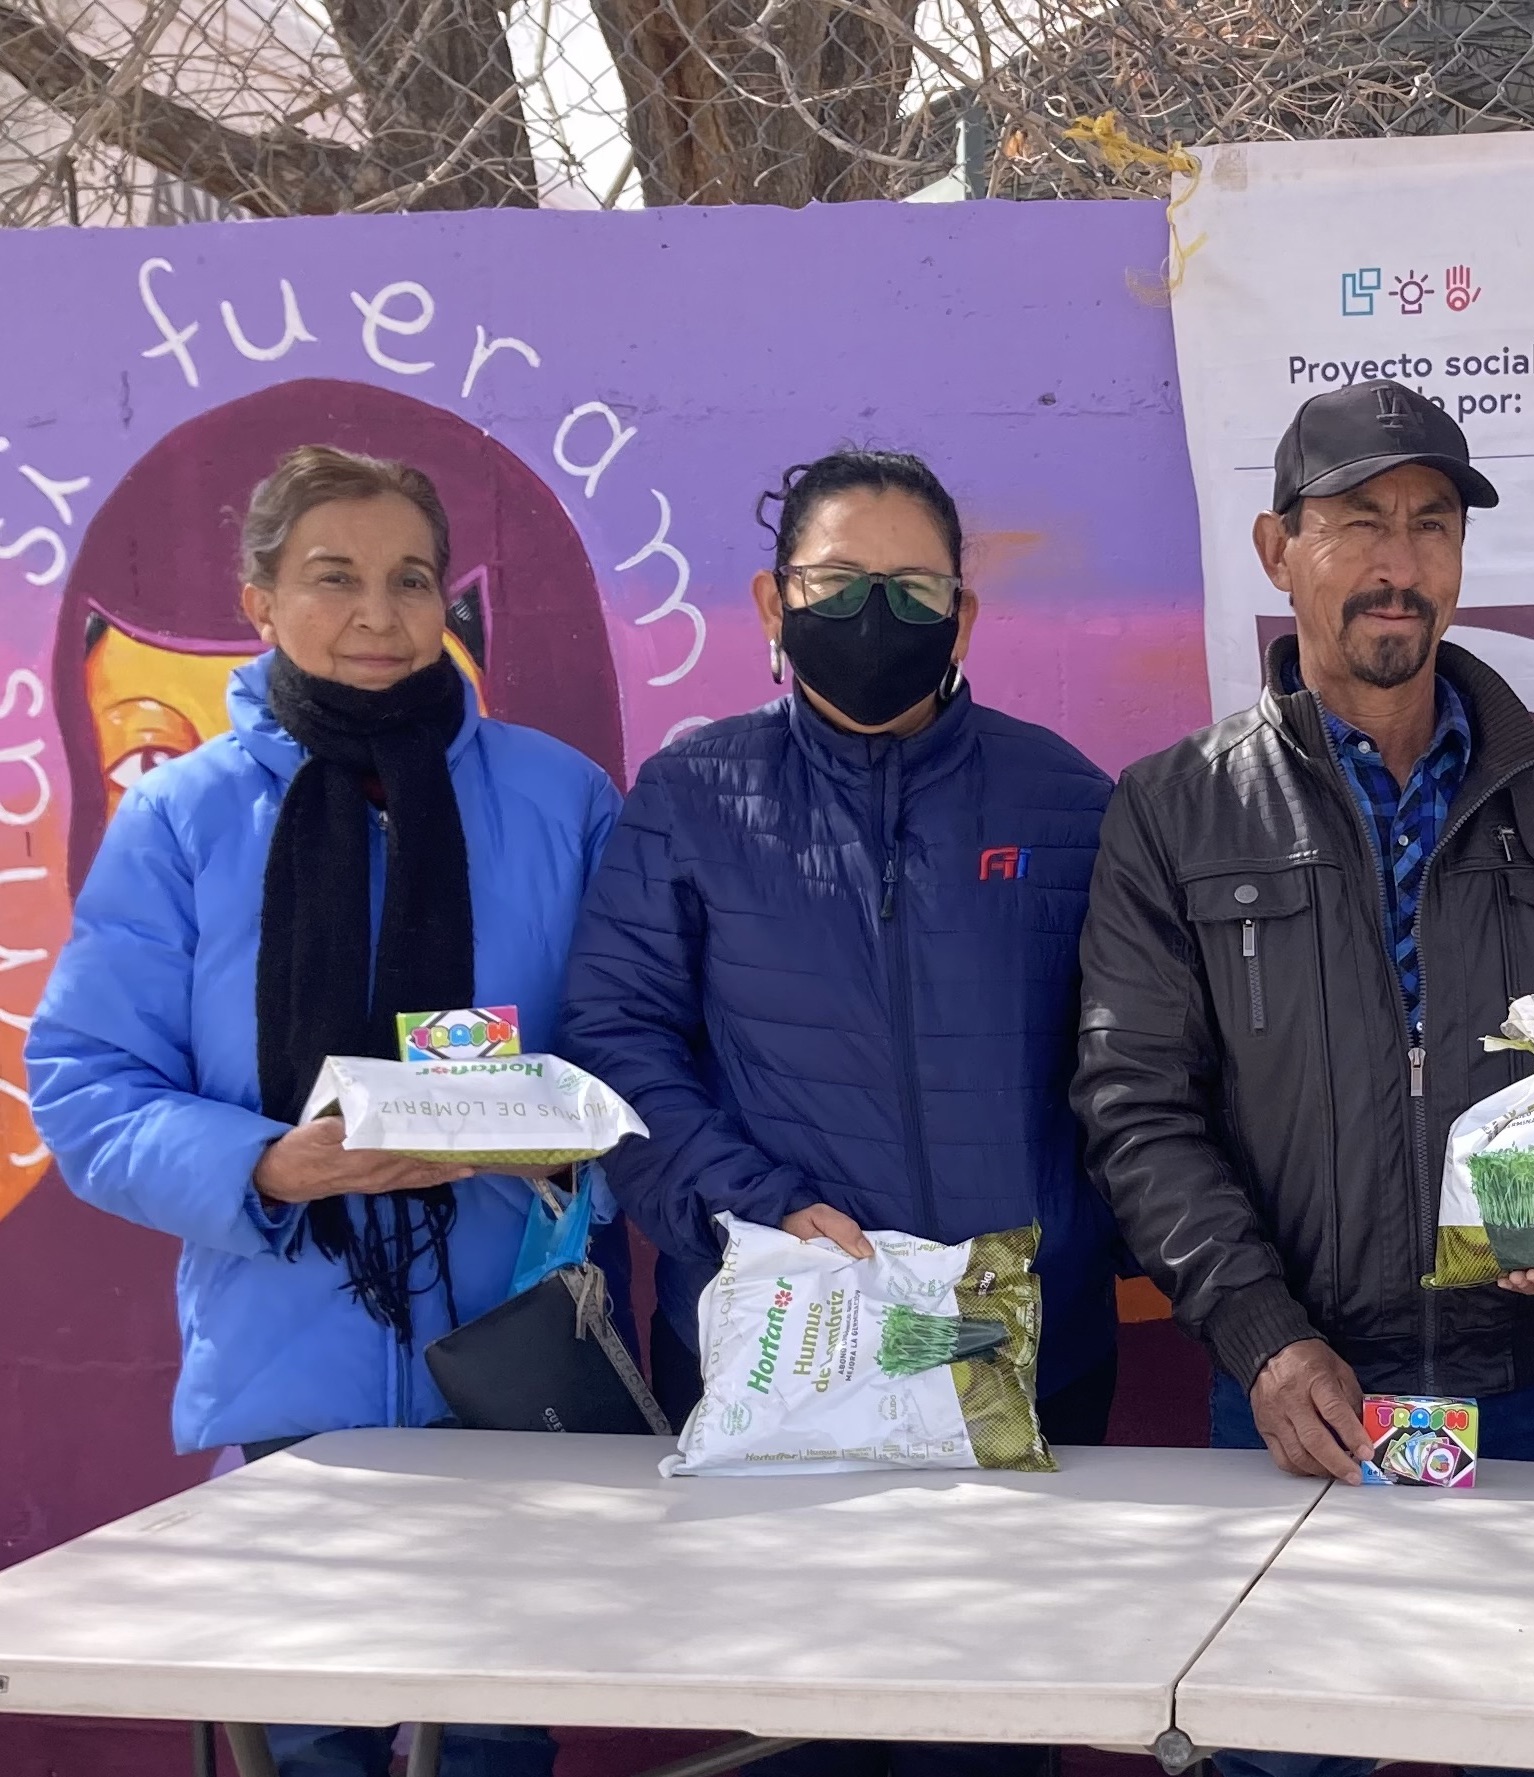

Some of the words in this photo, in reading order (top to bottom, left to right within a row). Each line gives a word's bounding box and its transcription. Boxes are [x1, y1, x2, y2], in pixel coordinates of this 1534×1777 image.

[1288, 352, 1432, 387] Proyecto
[1456, 389, 1523, 423] por:
[415, 1061, 544, 1078] Hortaflor
[381, 1100, 487, 1118] LOMBRIZ
[499, 1102, 528, 1118] DE
[539, 1101, 609, 1122] HUMUS
[746, 1276, 794, 1395] Hortaflor
[792, 1302, 823, 1375] Humus
[819, 1289, 845, 1369] Lombriz
[850, 1338, 858, 1349] LA
[837, 1348, 848, 1376] ABONO
[845, 1350, 858, 1382] MEJORA
[810, 1366, 832, 1393] de
[1376, 1406, 1470, 1432] TRASH
